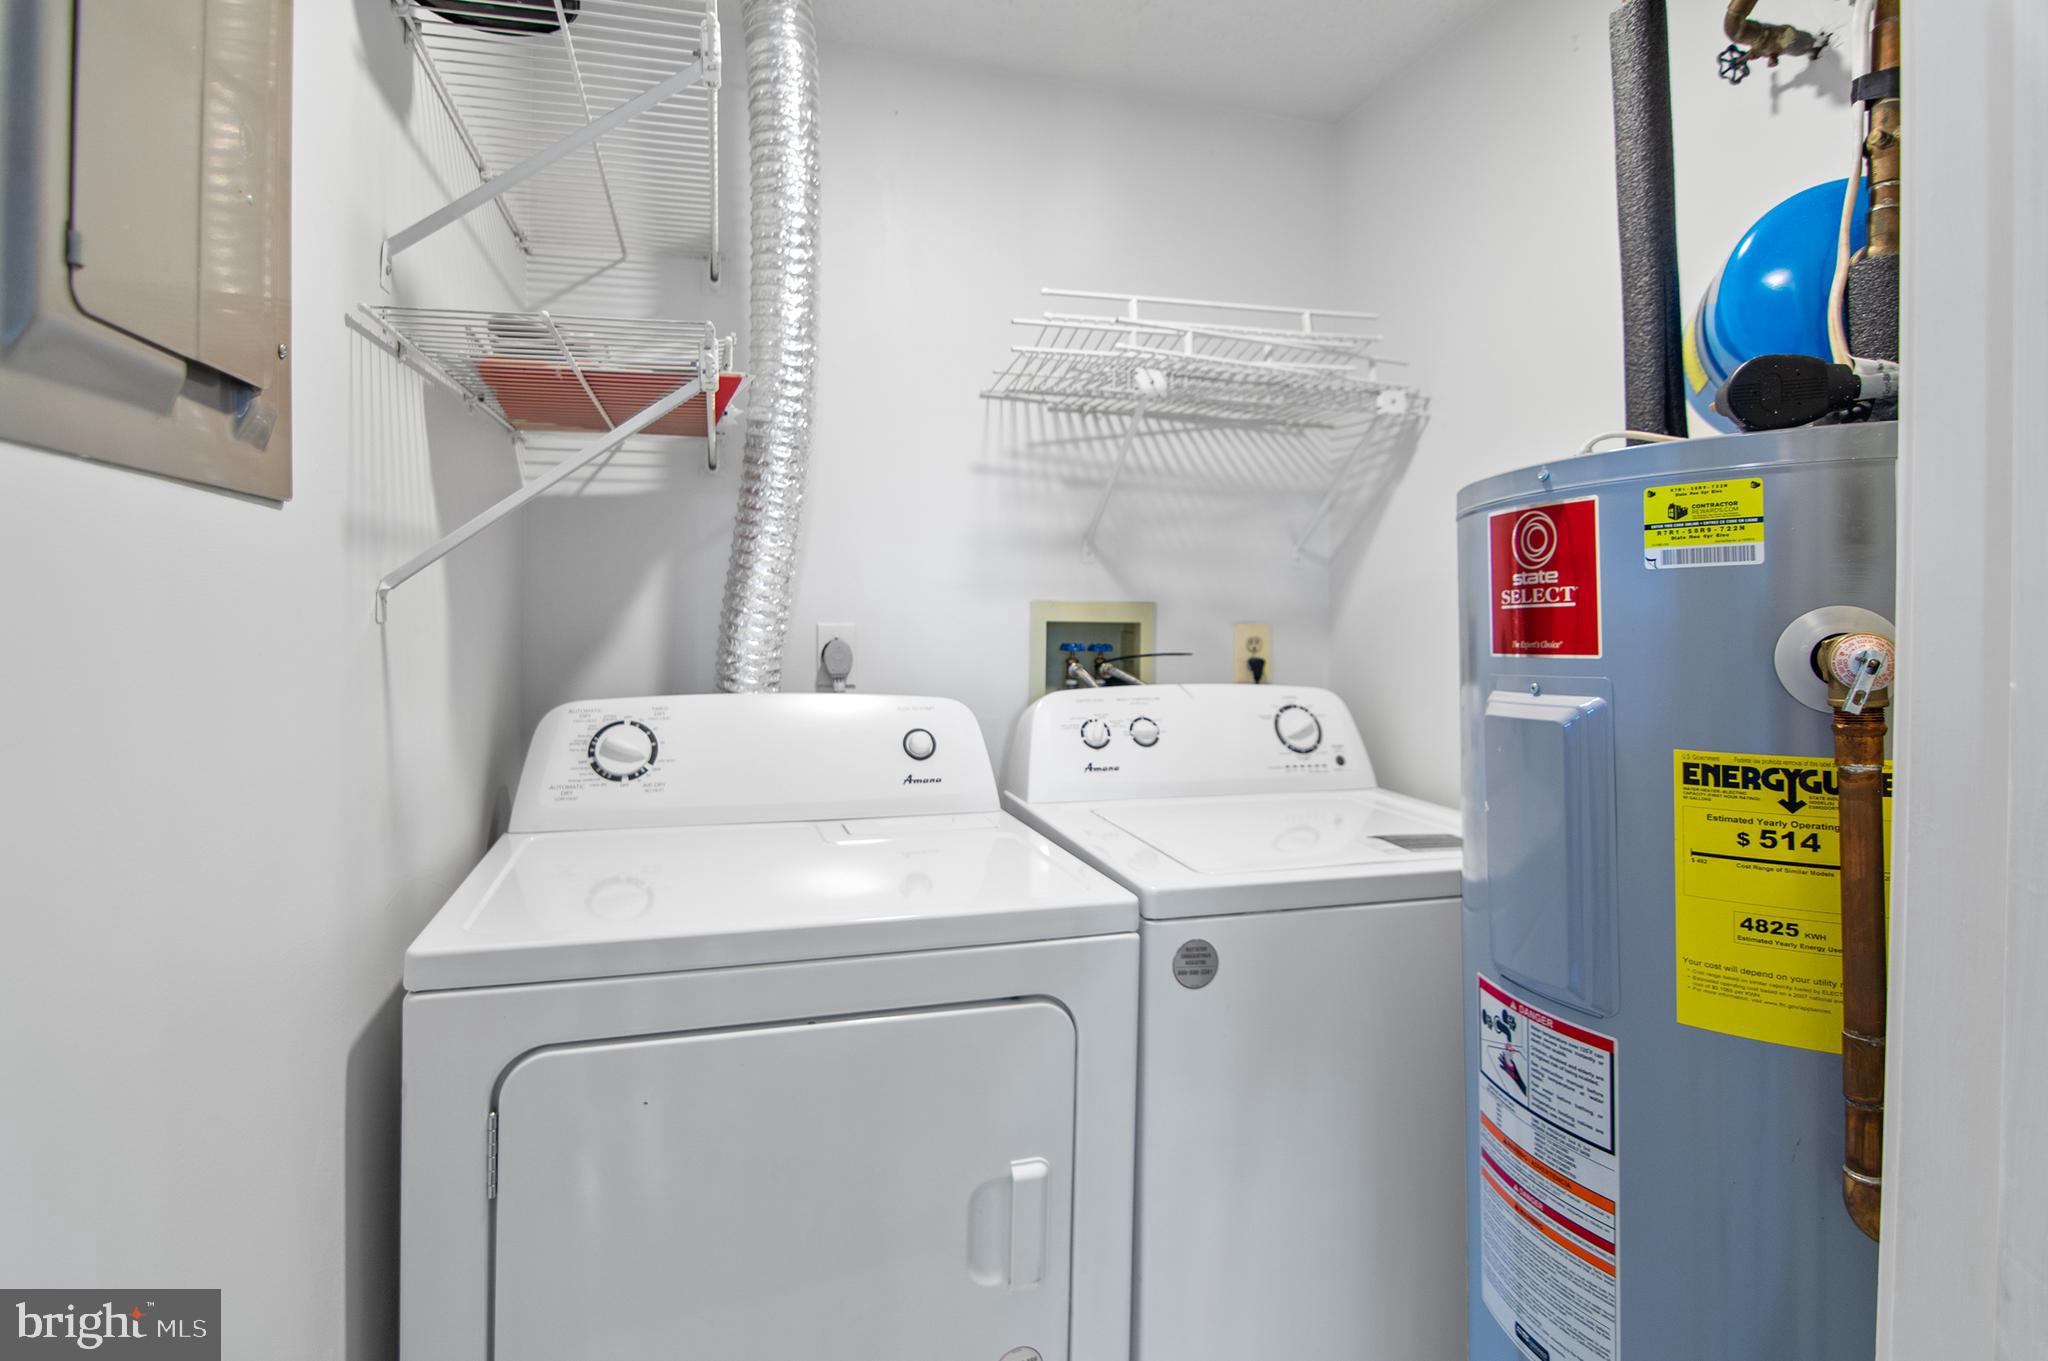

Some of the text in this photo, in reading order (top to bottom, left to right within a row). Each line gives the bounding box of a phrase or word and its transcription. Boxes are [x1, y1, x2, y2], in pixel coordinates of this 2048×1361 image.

[1691, 501, 1738, 509] CONTRACTOR
[1512, 570, 1559, 586] state
[1501, 586, 1576, 605] SELECT
[1084, 763, 1120, 773] Amana
[903, 774, 942, 784] Amana
[1707, 813, 1840, 833] Estimated Yearly Operating
[1736, 829, 1821, 853] $ 514
[1753, 864, 1774, 872] Range
[1740, 917, 1827, 941] 4825 KWH
[1737, 934, 1773, 946] Estimated
[1774, 939, 1798, 950] Yearly
[1800, 943, 1826, 953] Energy
[1682, 957, 1702, 968] Your
[1704, 962, 1722, 971] cost
[1723, 964, 1739, 973] will
[1740, 967, 1774, 981] depend
[1776, 973, 1788, 981] on
[1789, 976, 1810, 986] your
[1812, 977, 1838, 989] utility
[1519, 1005, 1553, 1028] DANGER
